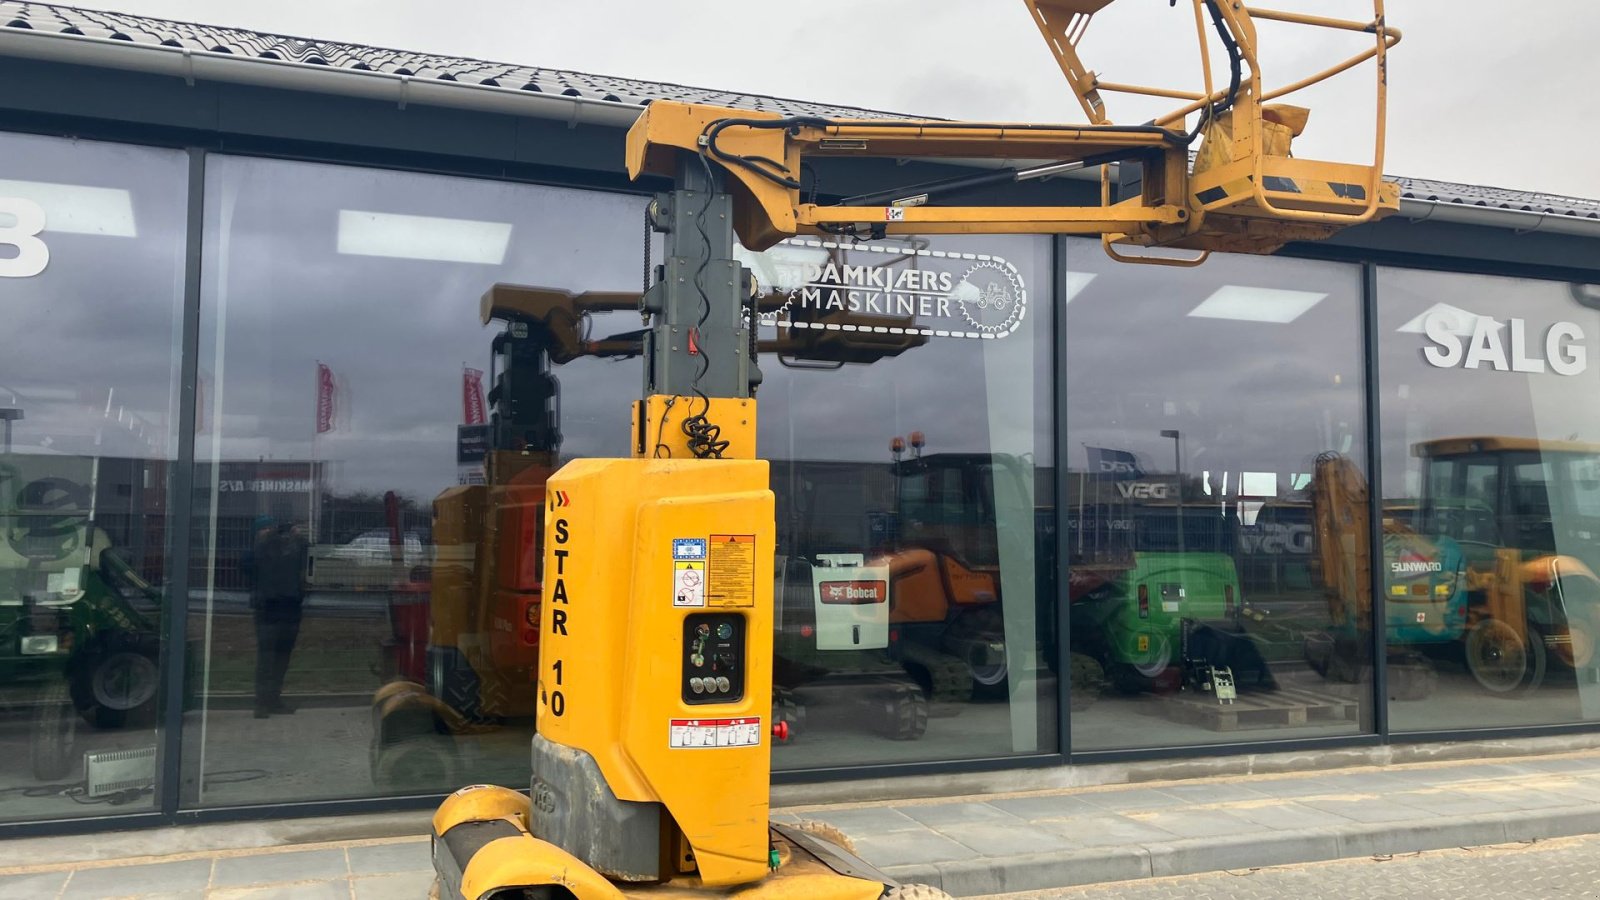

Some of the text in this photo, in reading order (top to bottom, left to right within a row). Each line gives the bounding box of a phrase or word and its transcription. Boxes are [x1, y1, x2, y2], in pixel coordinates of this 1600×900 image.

[803, 263, 952, 292] DAMKJÆRS
[801, 288, 951, 317] MASKINER
[1424, 312, 1587, 376] SALG
[1391, 561, 1442, 572] SUNWARD
[846, 586, 878, 599] Bobcat
[551, 518, 569, 717] STAR 10
